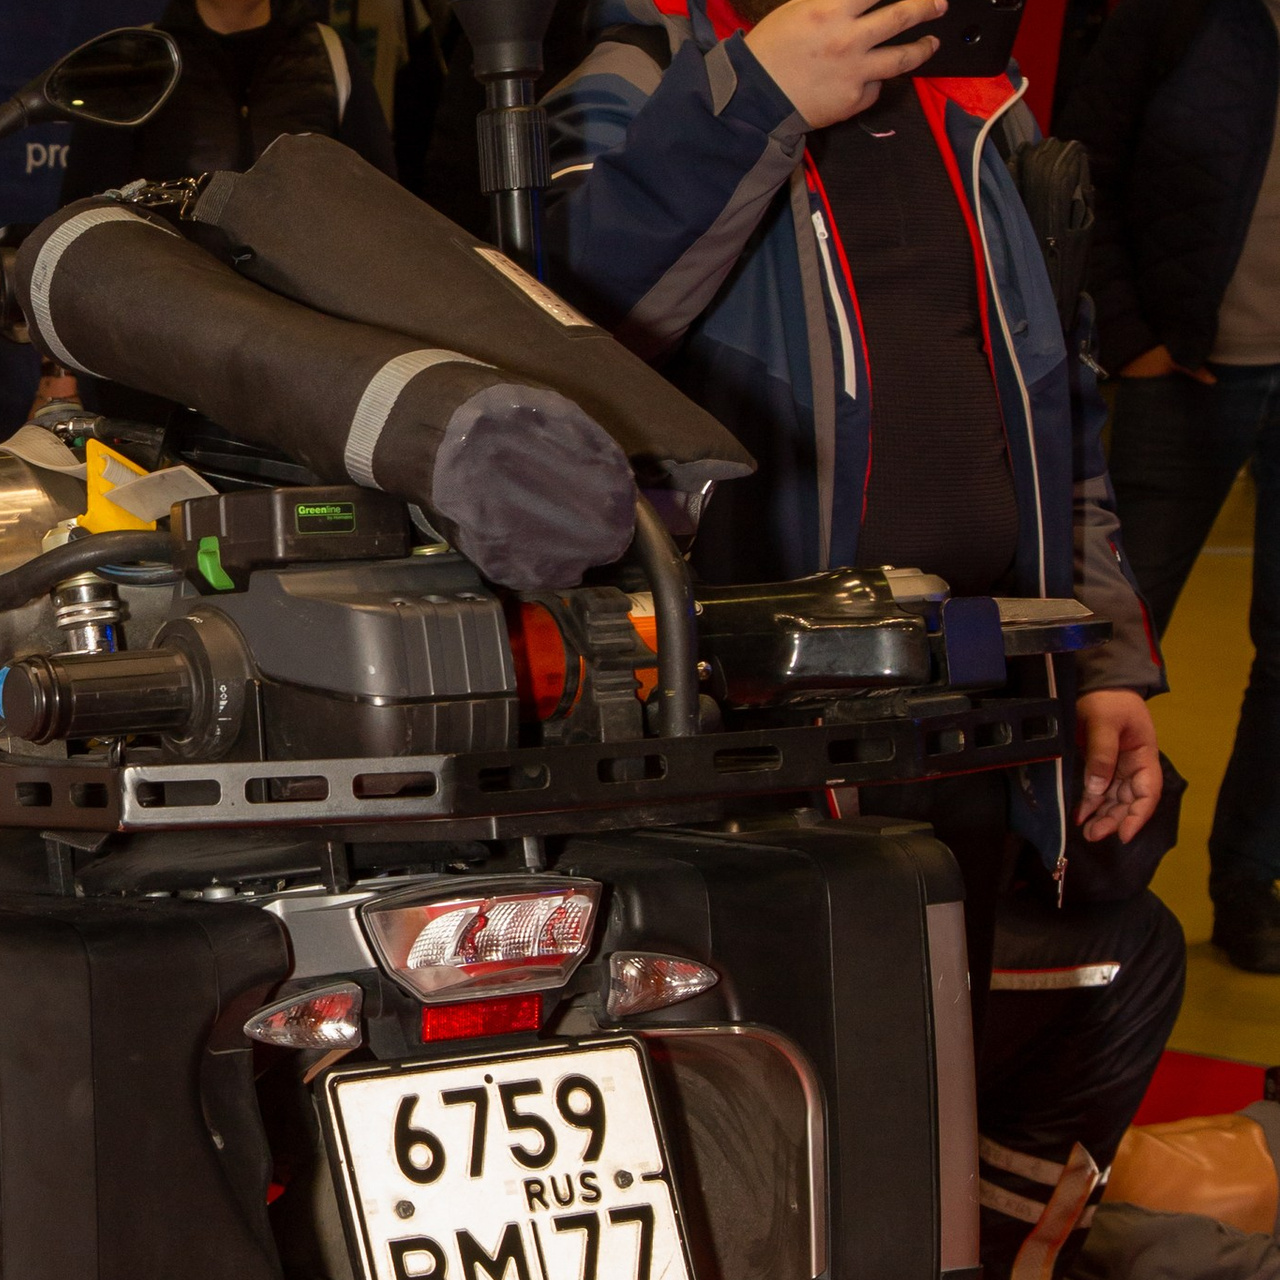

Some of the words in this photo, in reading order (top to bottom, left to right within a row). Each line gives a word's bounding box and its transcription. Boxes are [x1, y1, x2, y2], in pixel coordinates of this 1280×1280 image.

[298, 505, 342, 515] Greenline
[394, 1072, 607, 1185] 6759
[524, 1171, 602, 1211] RUS
